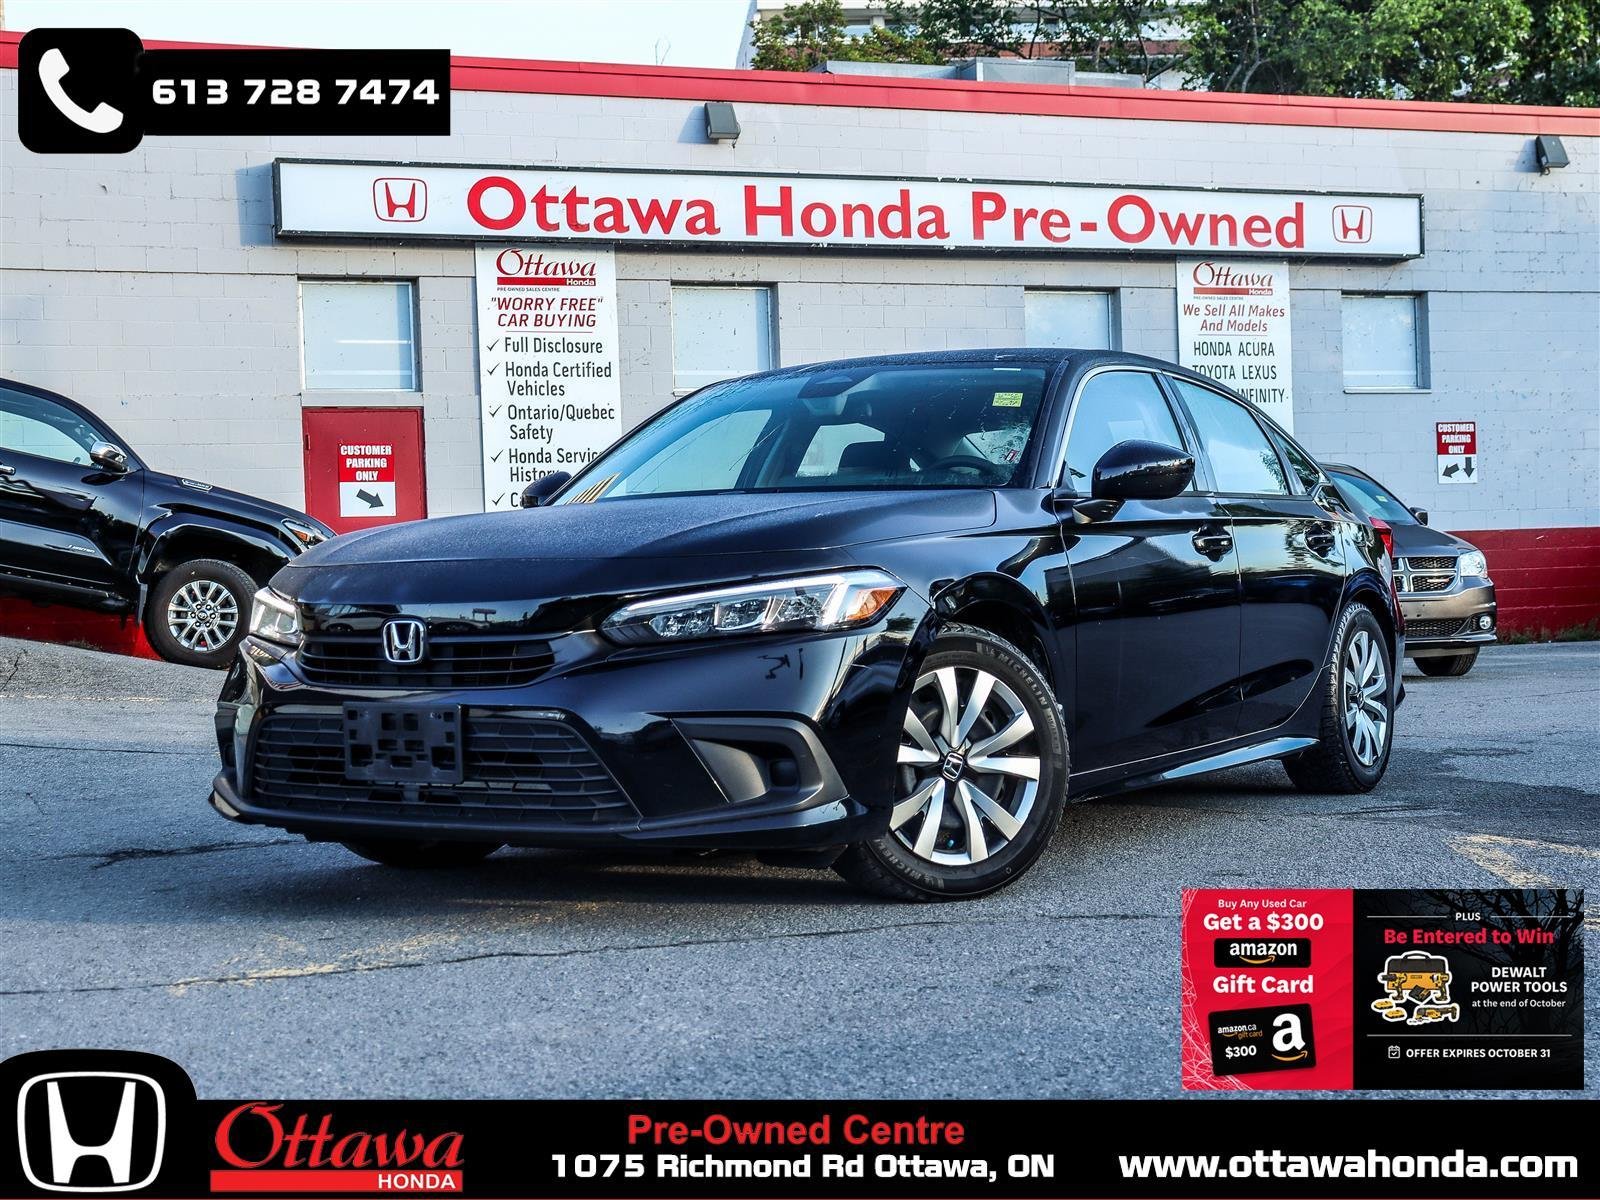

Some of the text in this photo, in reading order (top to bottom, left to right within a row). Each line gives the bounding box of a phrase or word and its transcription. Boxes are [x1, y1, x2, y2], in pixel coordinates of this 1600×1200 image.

[467, 175, 721, 236] Ottawa
[744, 185, 950, 241] Honda
[496, 248, 597, 276] Ottawa
[1193, 261, 1274, 286] Ottawa
[566, 278, 595, 286] Honda
[1248, 288, 1273, 296] Honda
[491, 297, 603, 311] "WORRY FREE"
[1183, 304, 1285, 317] We Sell All Makes
[497, 313, 596, 328] CAR BUYING
[1200, 319, 1268, 332] And Models
[504, 336, 603, 354] Full Disclosure
[1193, 341, 1275, 356] HONDA ACURA
[505, 361, 612, 378] Honda Certified
[1242, 365, 1277, 380] LEXUS
[507, 380, 566, 396] Vehicles
[508, 403, 615, 421] Ontario/Quebec
[510, 423, 554, 444] Safety
[1438, 423, 1474, 432] CUSTOMER
[1441, 434, 1472, 443] PARKING
[340, 445, 392, 456] CUSTOMER
[508, 447, 602, 464] Honda Servic
[1448, 445, 1465, 454] ONLY
[345, 458, 388, 468] PARKING
[355, 471, 379, 480] ONLY
[997, 651, 1048, 705] MICHELIN
